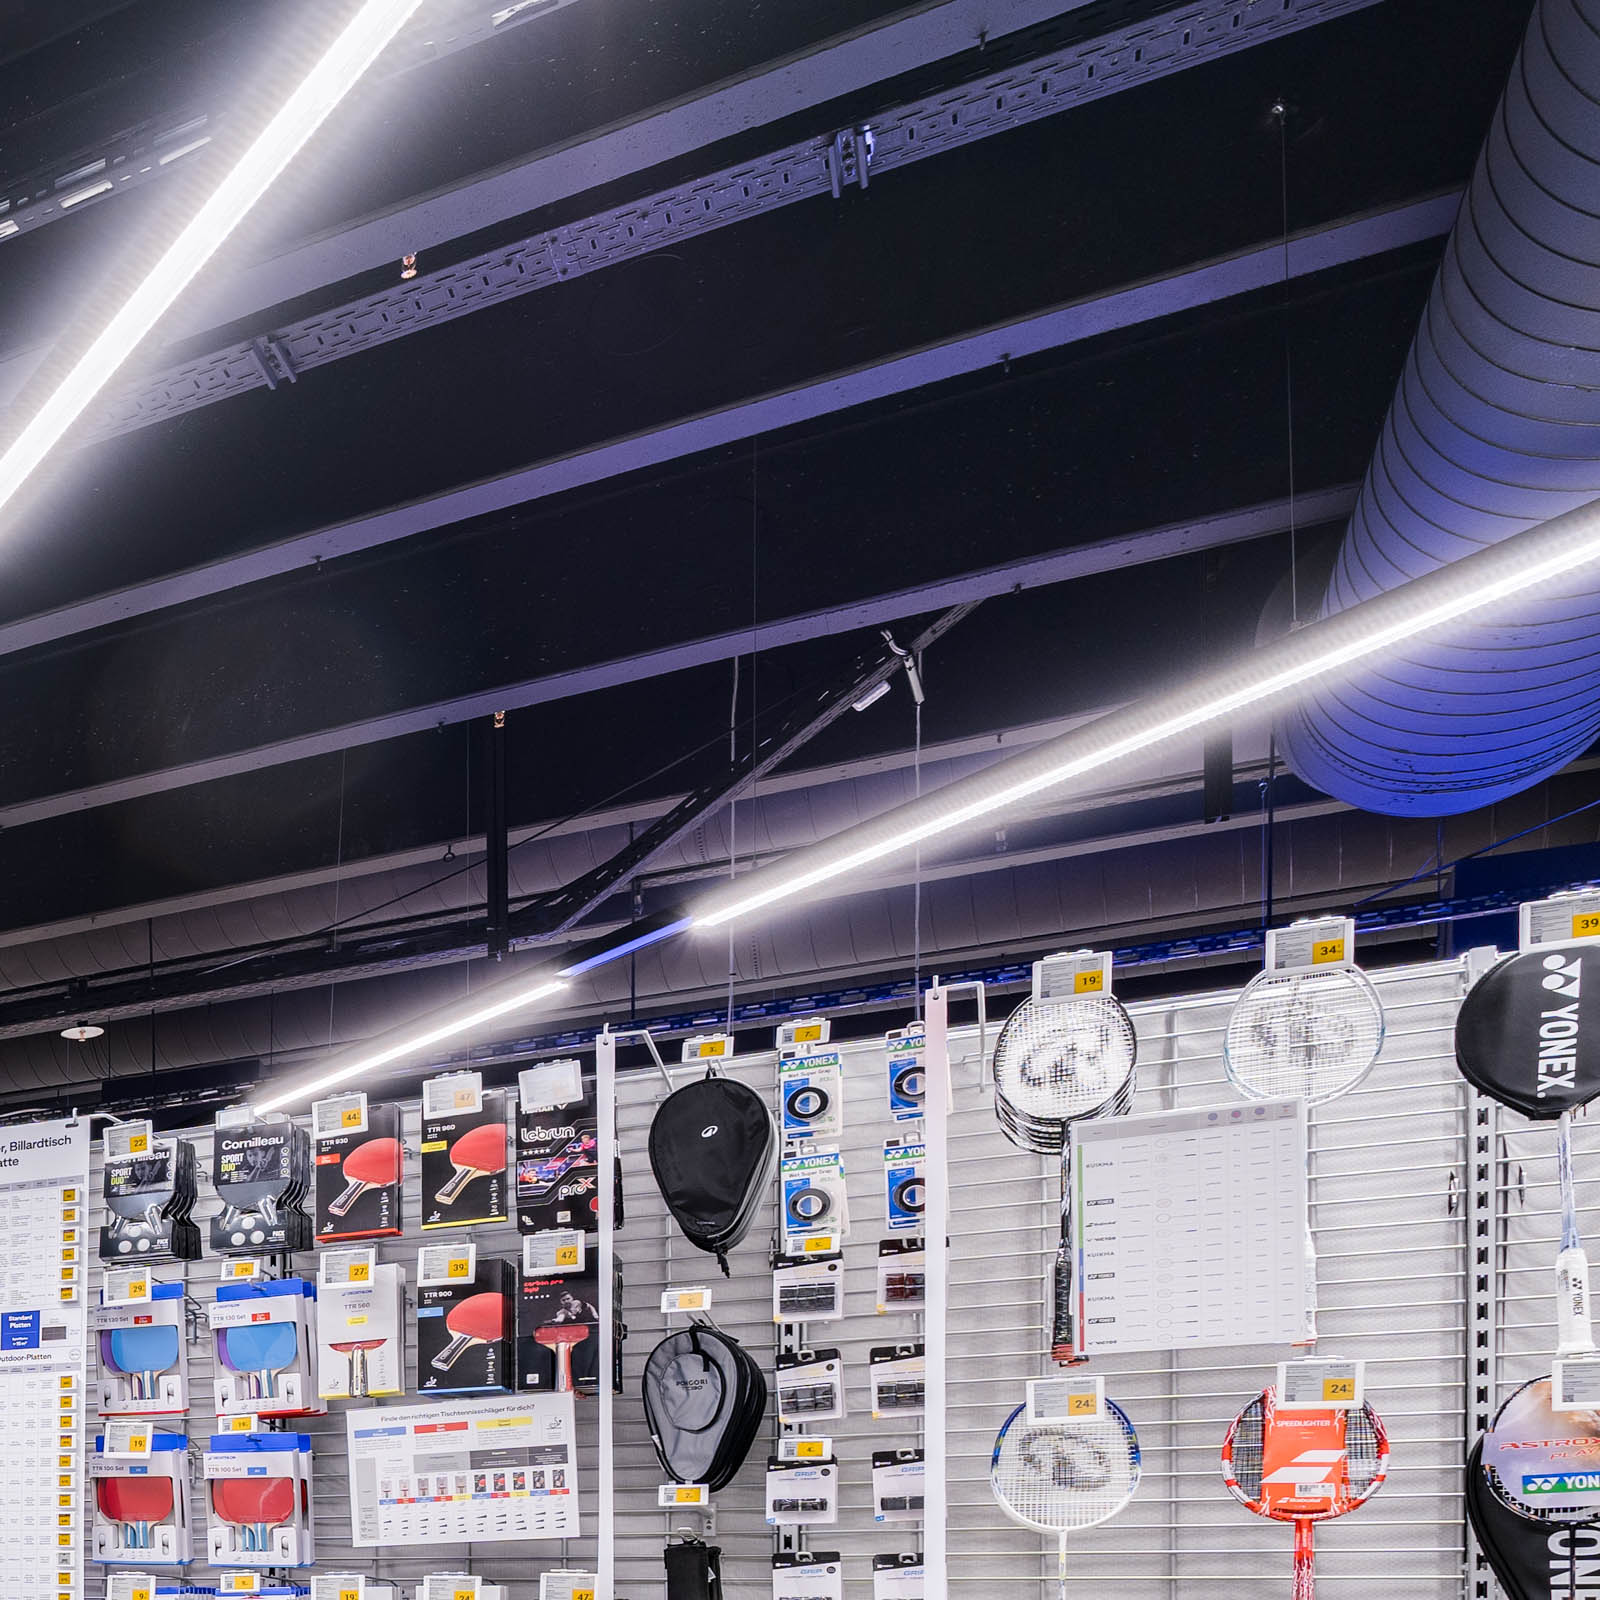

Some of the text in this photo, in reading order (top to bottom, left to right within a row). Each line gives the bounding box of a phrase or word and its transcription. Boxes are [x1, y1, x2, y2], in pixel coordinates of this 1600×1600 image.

[803, 1054, 835, 1067] YONEX
[521, 1126, 574, 1142] lebrun
[9, 1136, 71, 1151] Billardtisch
[222, 1136, 284, 1150] Cornilleau
[221, 1153, 244, 1163] SPORT
[805, 1155, 837, 1167] YONEX
[111, 1167, 132, 1177] SPORT
[221, 1163, 236, 1173] DUO
[111, 1177, 125, 1185] DUO
[1572, 1292, 1584, 1317] YONEX
[410, 1407, 505, 1421] richtigen Tischtennisschläger
